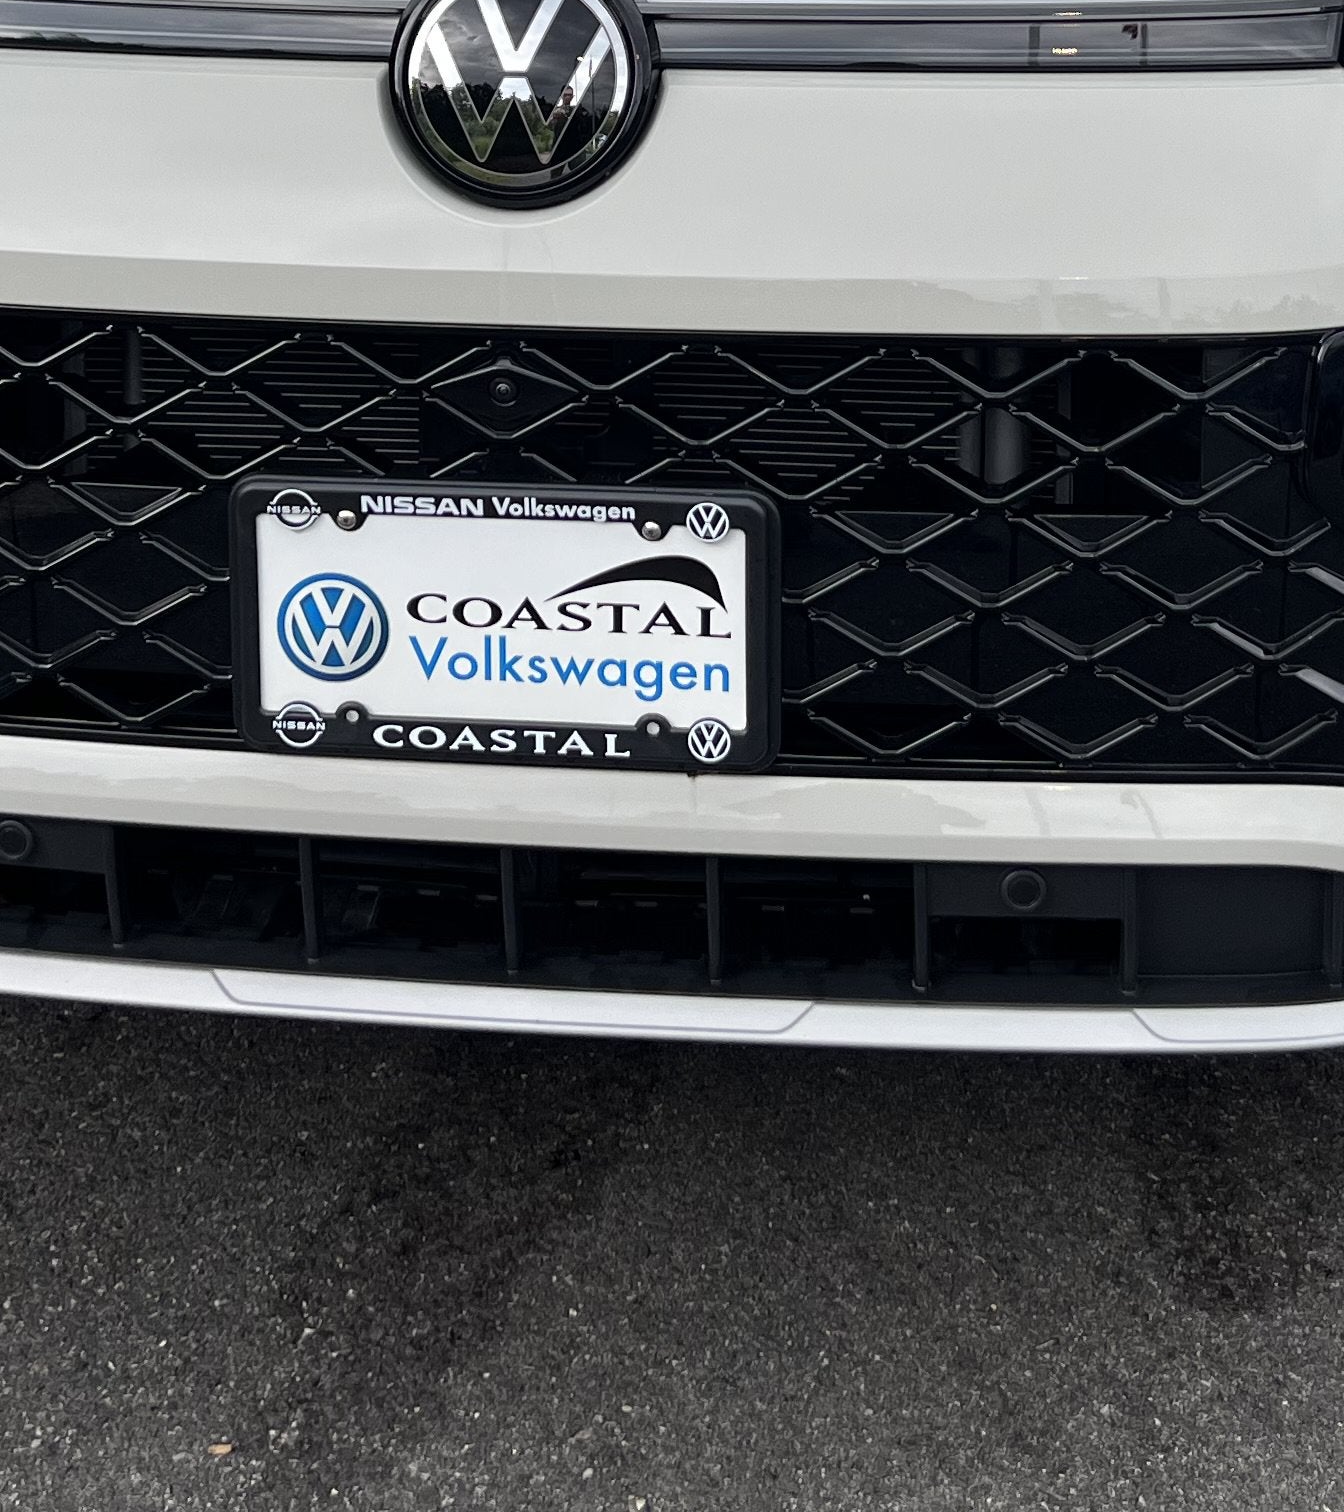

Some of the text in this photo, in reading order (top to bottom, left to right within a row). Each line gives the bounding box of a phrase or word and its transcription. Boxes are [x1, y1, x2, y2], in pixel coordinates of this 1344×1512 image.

[266, 505, 321, 514] NISSAN
[360, 494, 636, 523] NISSAN Volkswagen
[406, 592, 732, 639] COASTAL
[408, 635, 730, 702] Volkswagen
[272, 720, 325, 731] NISSAN
[372, 724, 631, 758] COASTAL
